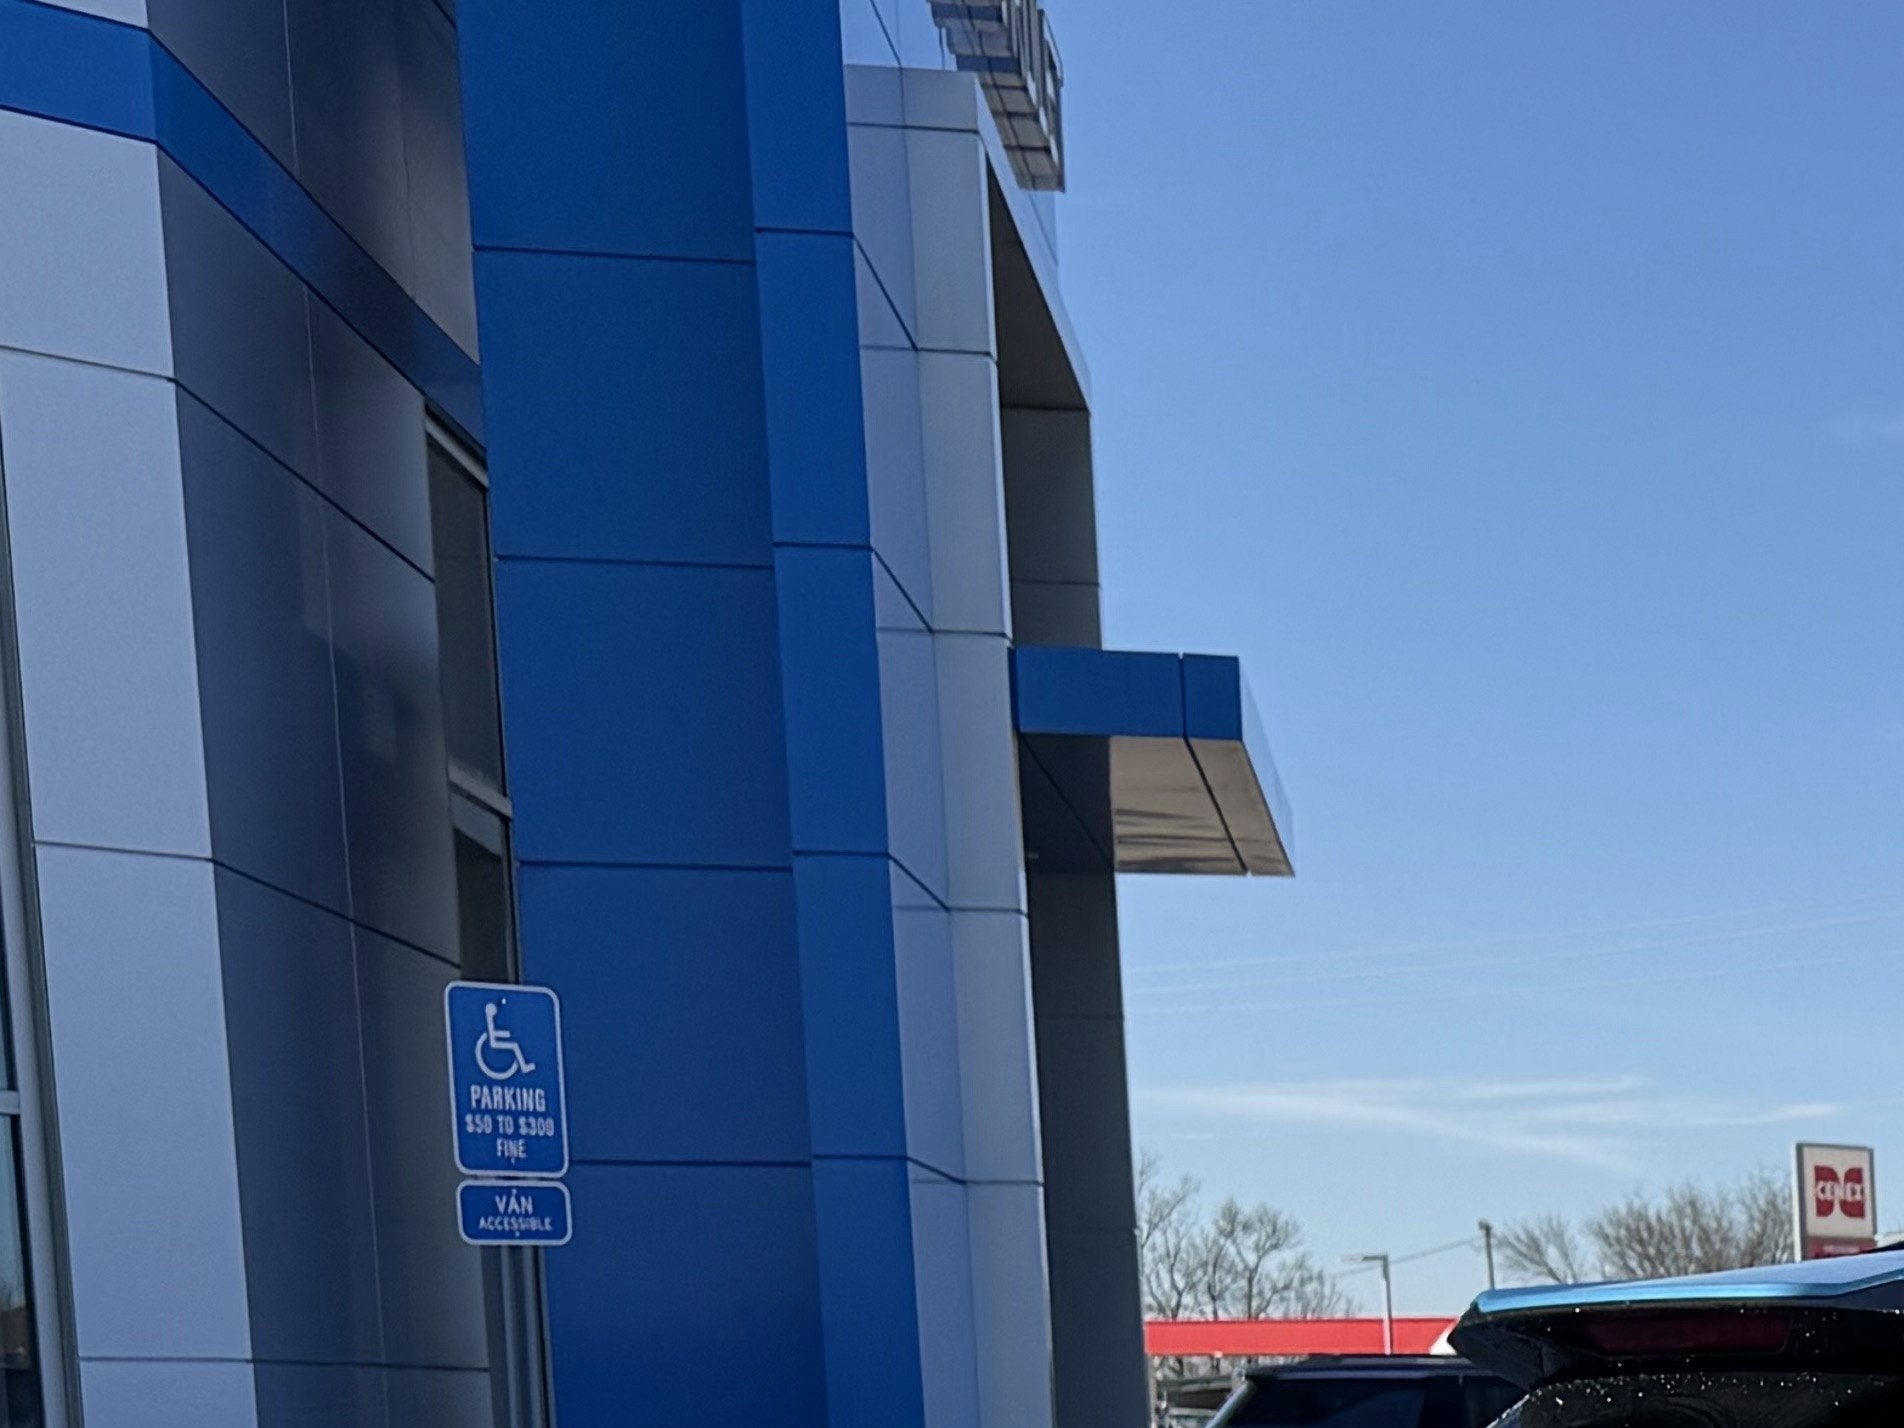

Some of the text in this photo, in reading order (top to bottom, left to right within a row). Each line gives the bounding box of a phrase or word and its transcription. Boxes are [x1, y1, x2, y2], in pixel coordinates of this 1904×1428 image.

[470, 1084, 546, 1112] PARKING
[465, 1114, 555, 1137] $50 TO $300
[496, 1138, 527, 1159] FINE
[495, 1195, 533, 1215] VAN
[478, 1216, 553, 1232] ACCESSIBLE
